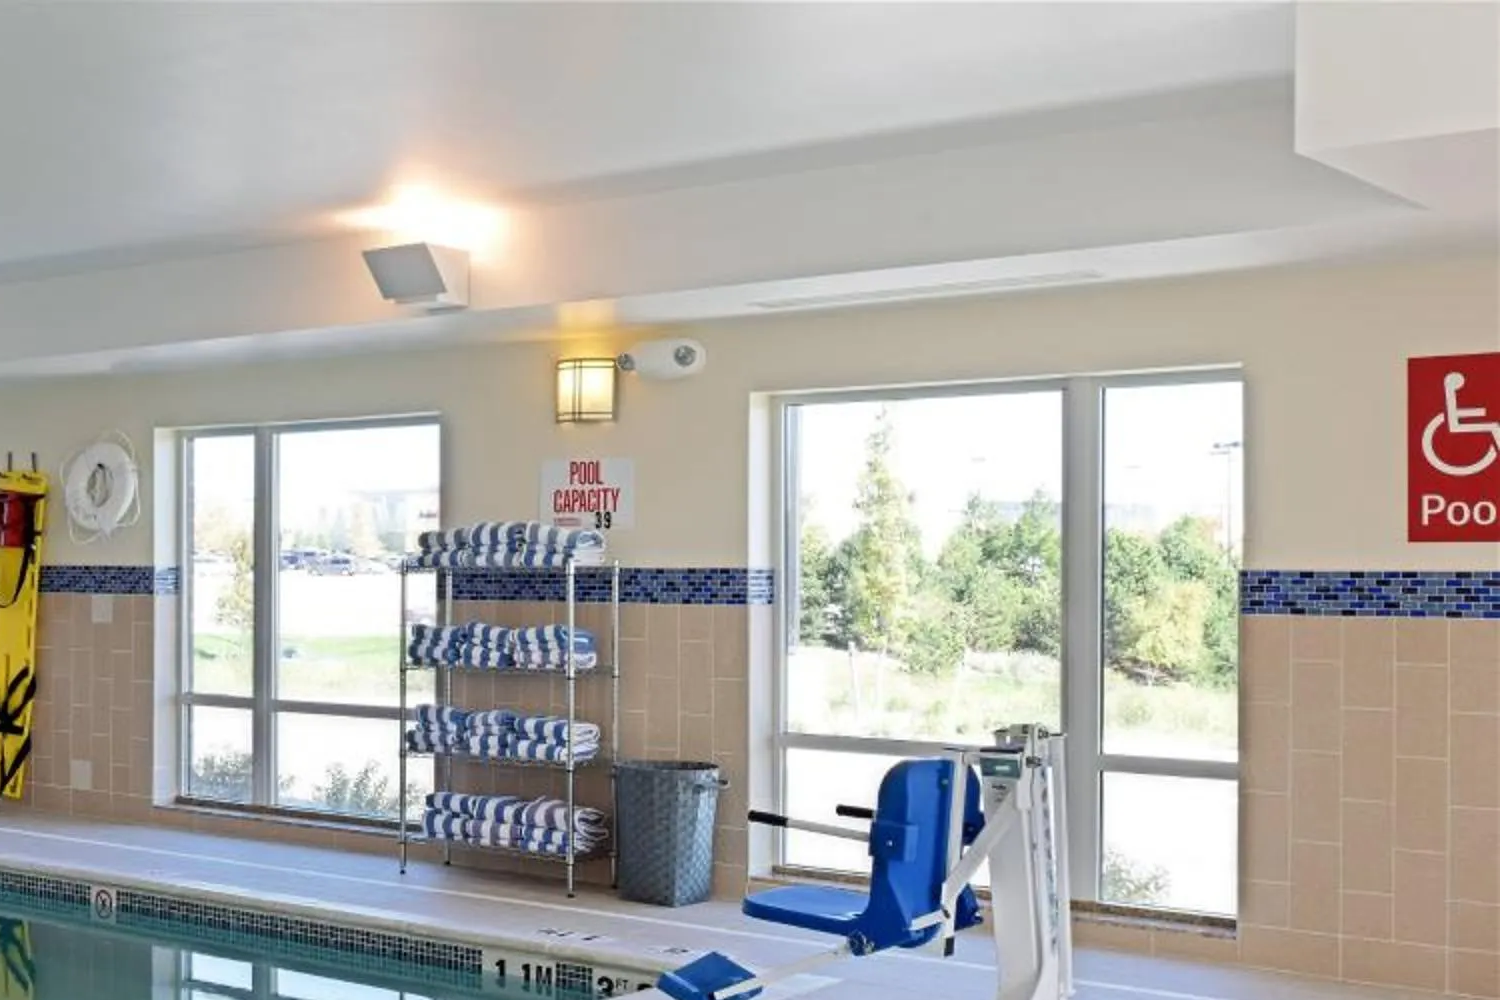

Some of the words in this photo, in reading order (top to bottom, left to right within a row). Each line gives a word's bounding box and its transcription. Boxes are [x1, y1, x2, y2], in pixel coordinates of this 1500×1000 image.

[569, 461, 603, 485] POOL
[553, 487, 620, 512] CAPACITY
[1421, 494, 1498, 526] Poo
[595, 511, 612, 529] 39
